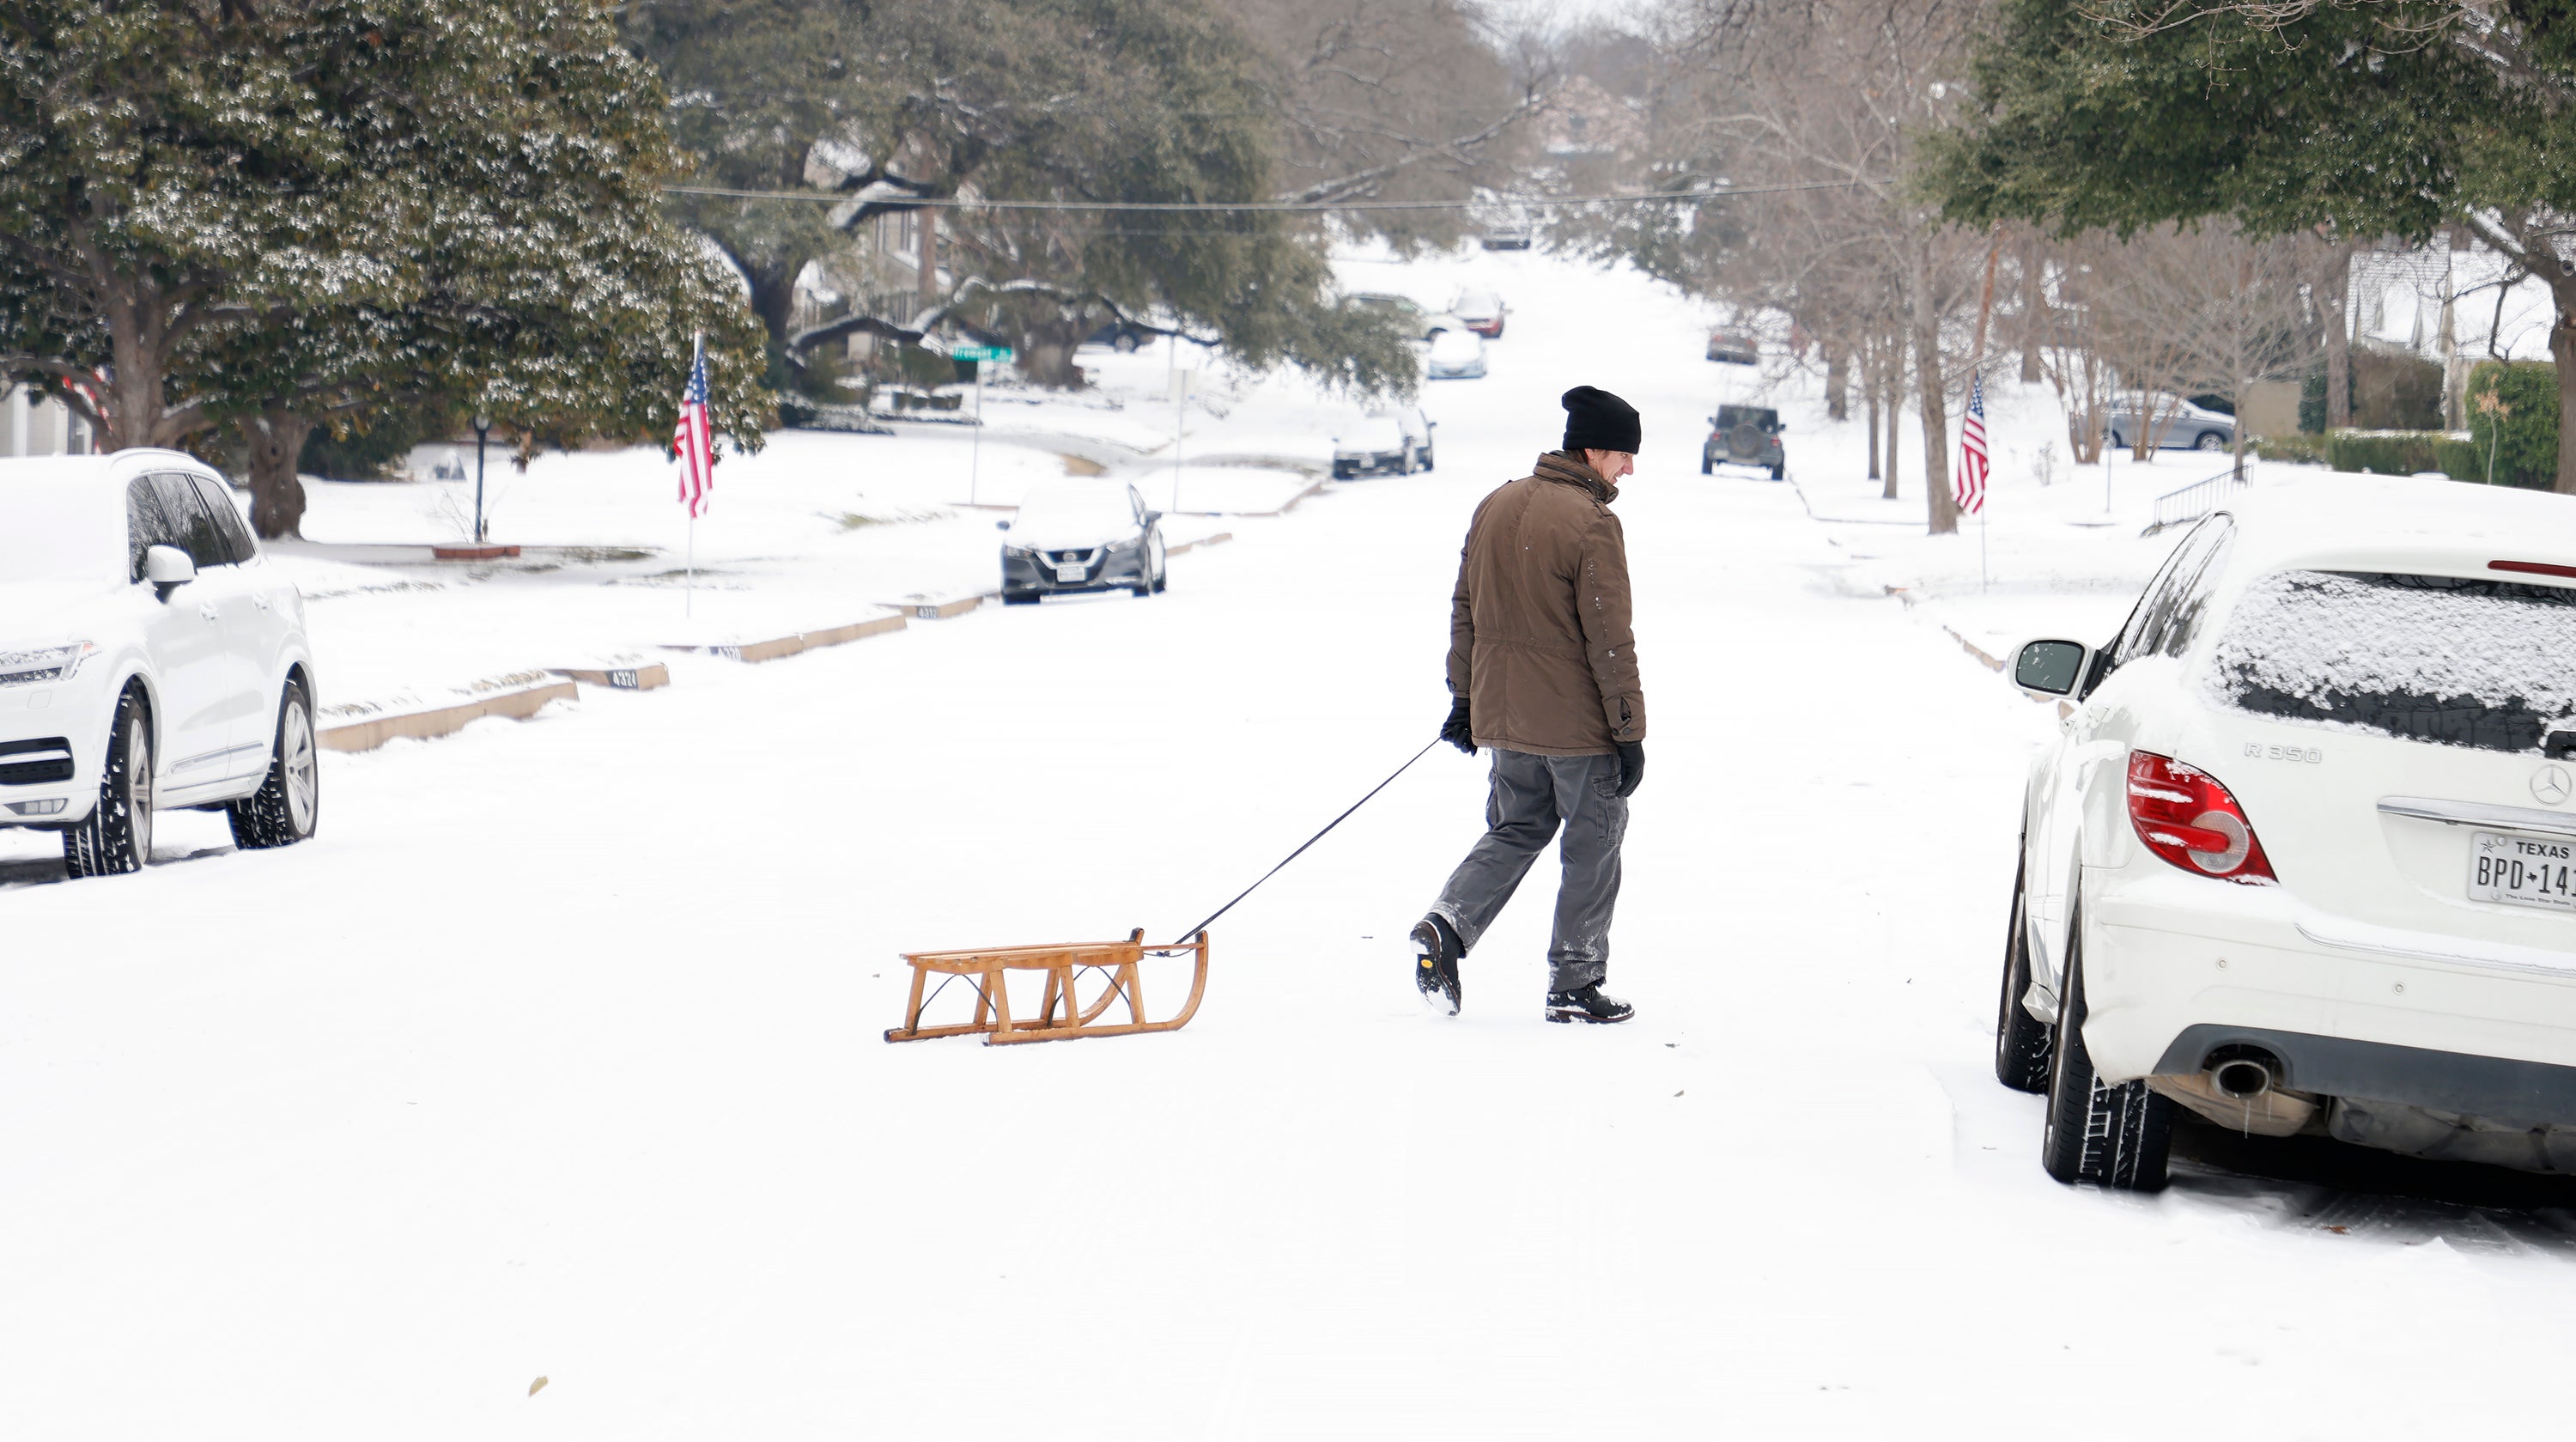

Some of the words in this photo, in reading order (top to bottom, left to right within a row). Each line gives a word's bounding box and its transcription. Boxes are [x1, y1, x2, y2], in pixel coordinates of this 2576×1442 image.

[954, 345, 992, 359] Tremont
[612, 670, 636, 687] 4324
[2245, 742, 2262, 758] R
[2268, 745, 2322, 764] 350
[2516, 842, 2569, 859] TEXAS
